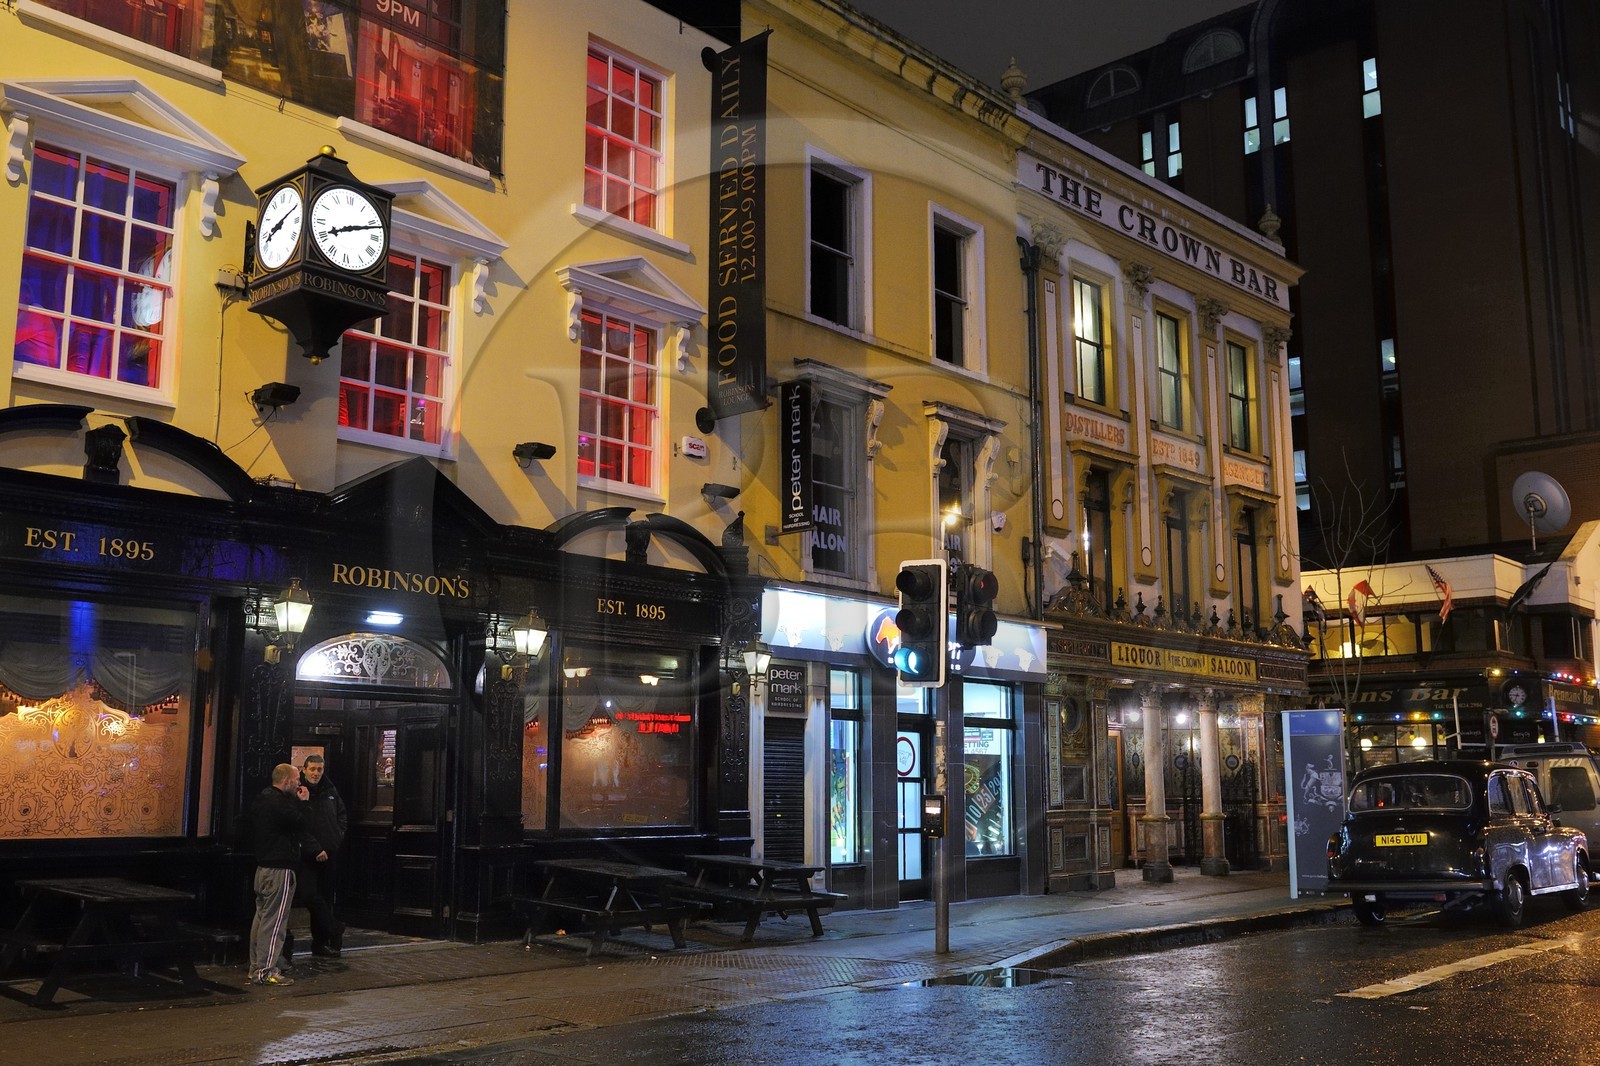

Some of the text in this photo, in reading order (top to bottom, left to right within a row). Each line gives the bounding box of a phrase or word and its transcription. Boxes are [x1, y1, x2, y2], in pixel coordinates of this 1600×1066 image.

[740, 124, 757, 285] 12.00-9.00PM
[717, 54, 741, 389] FOOD SERVED DAILY
[1036, 163, 1280, 302] THE CROWN BAR
[303, 272, 386, 306] ROBINSON'S
[1065, 412, 1125, 446] DISTILLERS
[688, 442, 705, 452] scan
[788, 385, 804, 511] peter mark
[1179, 446, 1200, 467] 1849
[812, 504, 842, 527] HAIR
[24, 527, 155, 561] EST. 1895
[812, 531, 847, 553] ALON
[944, 533, 962, 552] AIR
[332, 562, 470, 599] ROBINSON'S
[597, 598, 666, 620] EST. 1895
[1118, 645, 1162, 667] LIQUOR
[770, 668, 803, 681] peter
[771, 682, 802, 695] mark
[1409, 687, 1469, 701] Bar
[1583, 689, 1596, 706] Bar
[1548, 758, 1584, 768] TAXI
[976, 788, 992, 809] 25
[966, 804, 982, 825] 10
[1381, 834, 1422, 845] N146 OYU
